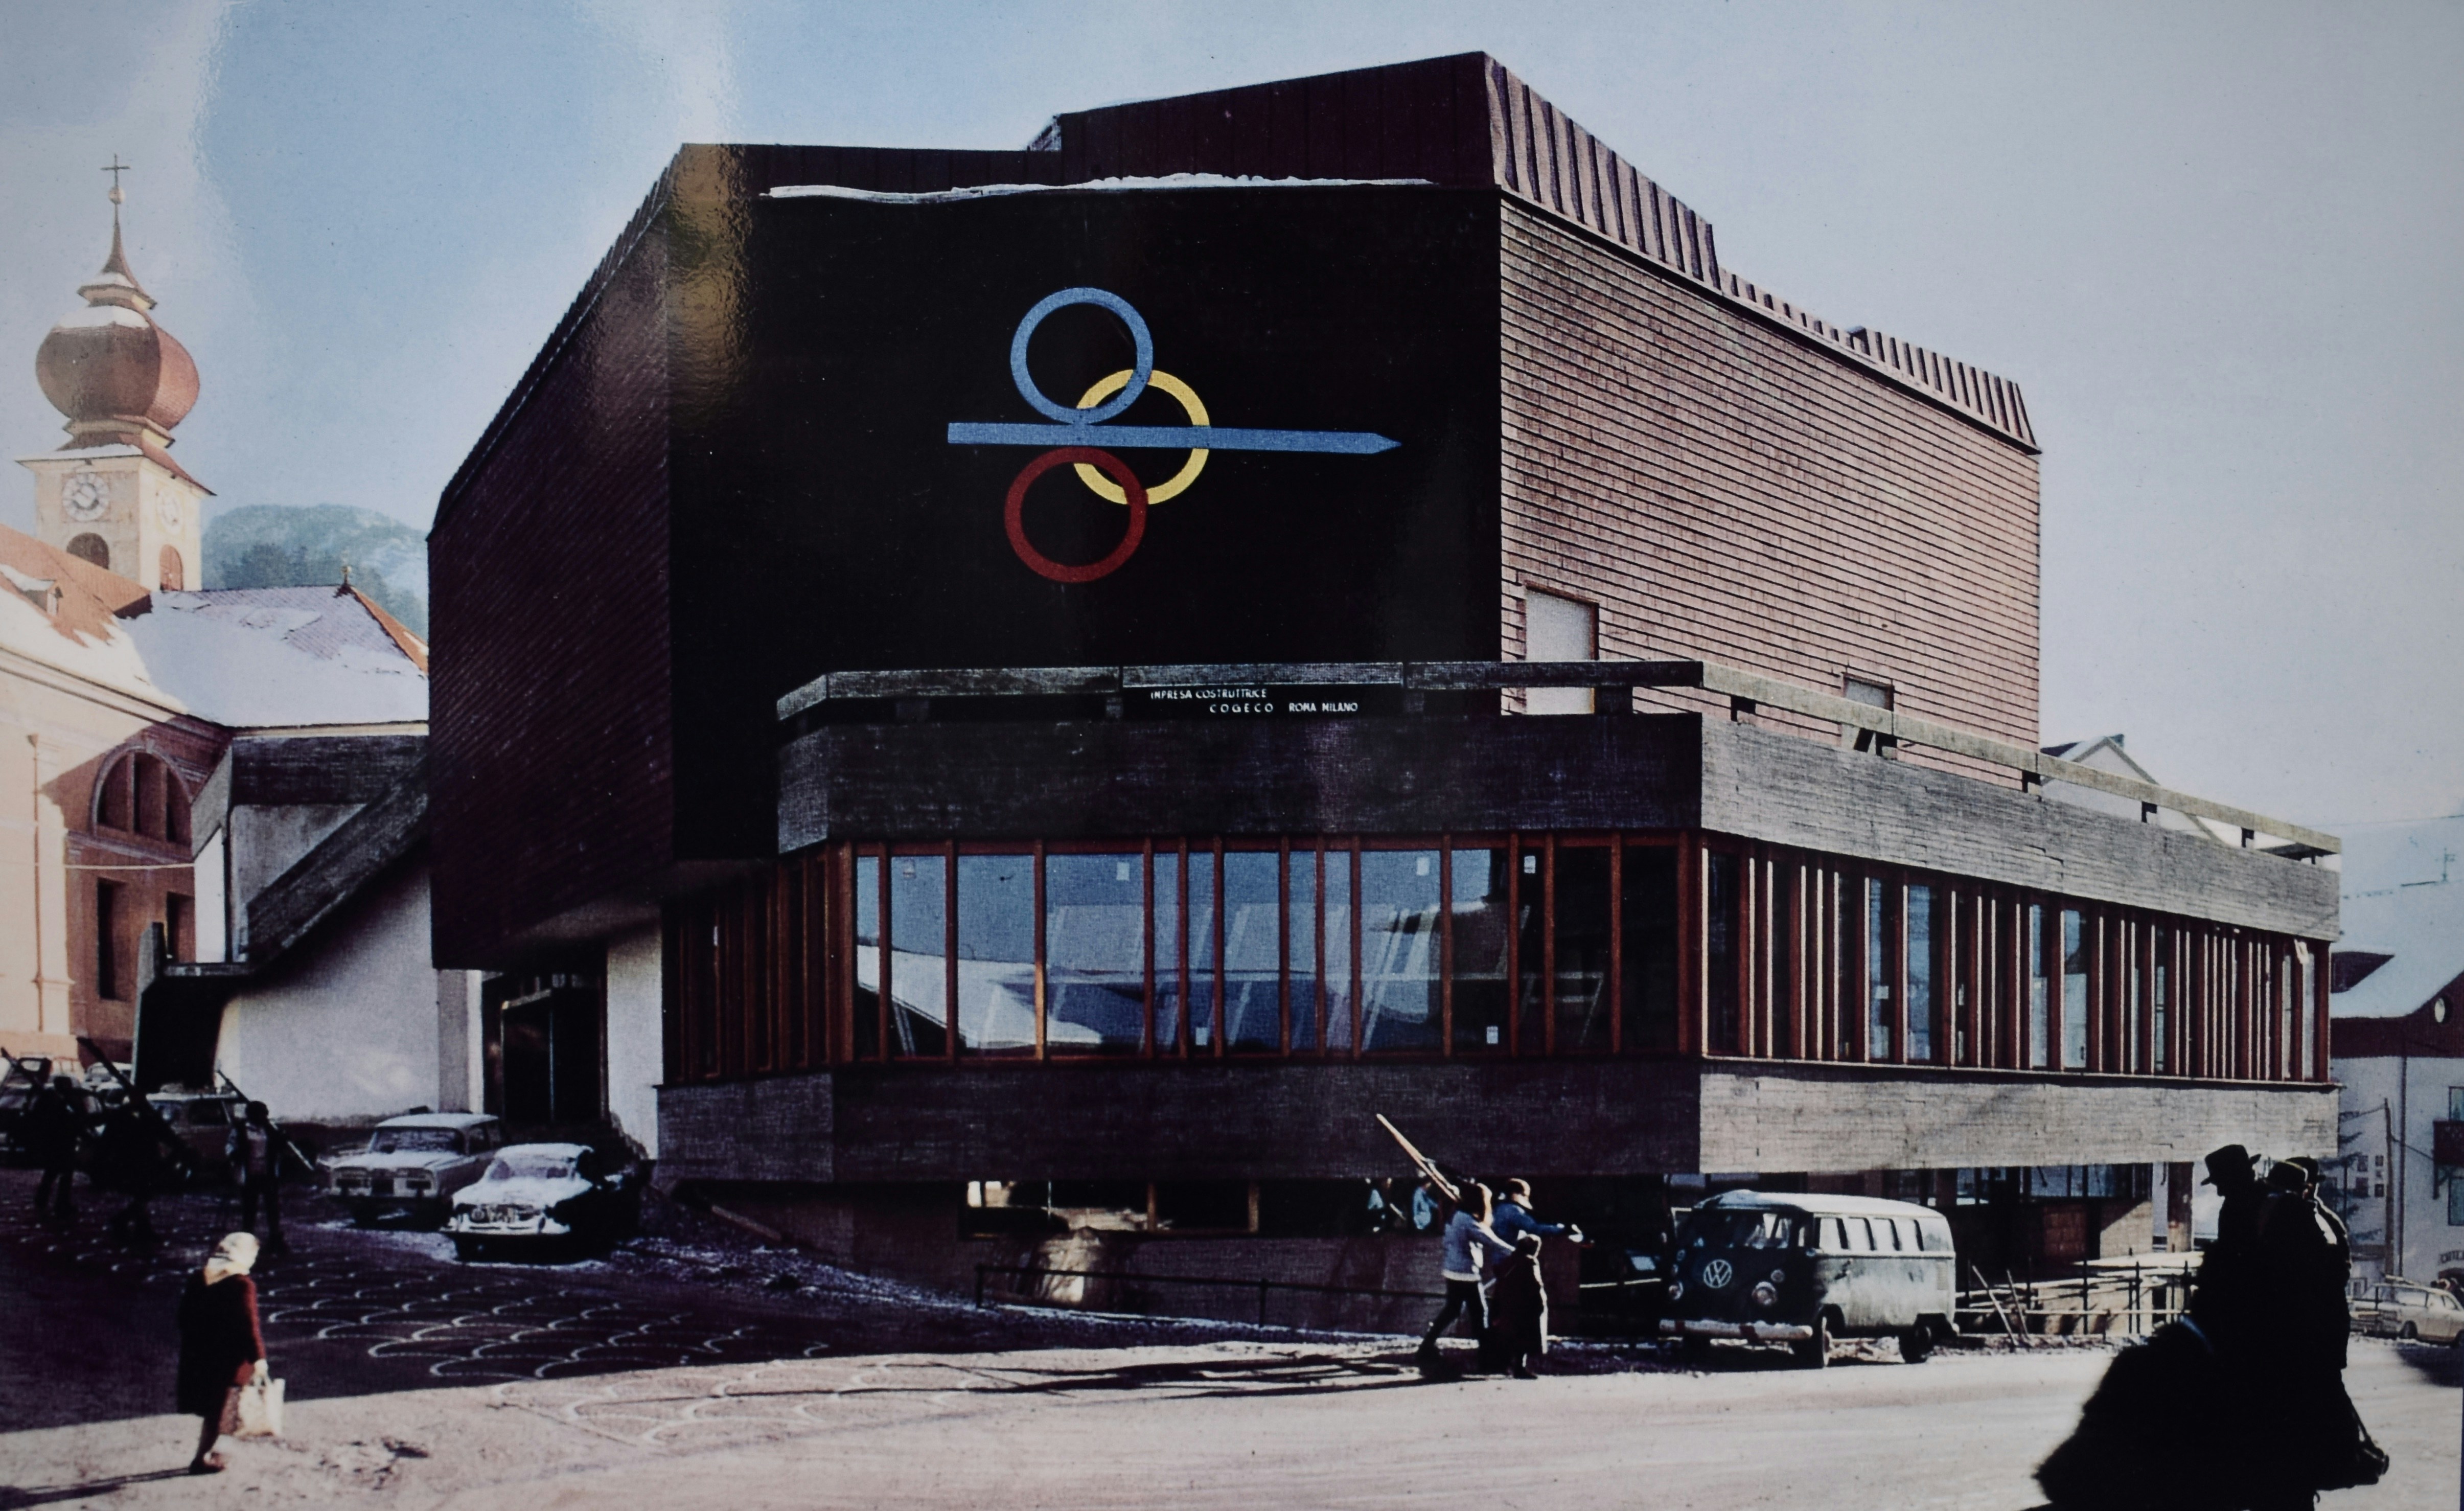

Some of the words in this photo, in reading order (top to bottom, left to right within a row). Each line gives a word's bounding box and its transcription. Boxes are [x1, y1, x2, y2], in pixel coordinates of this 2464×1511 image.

[1209, 703, 1274, 713] COGECO
[1288, 702, 1317, 712] ROMA
[1322, 702, 1358, 712] MILANO
